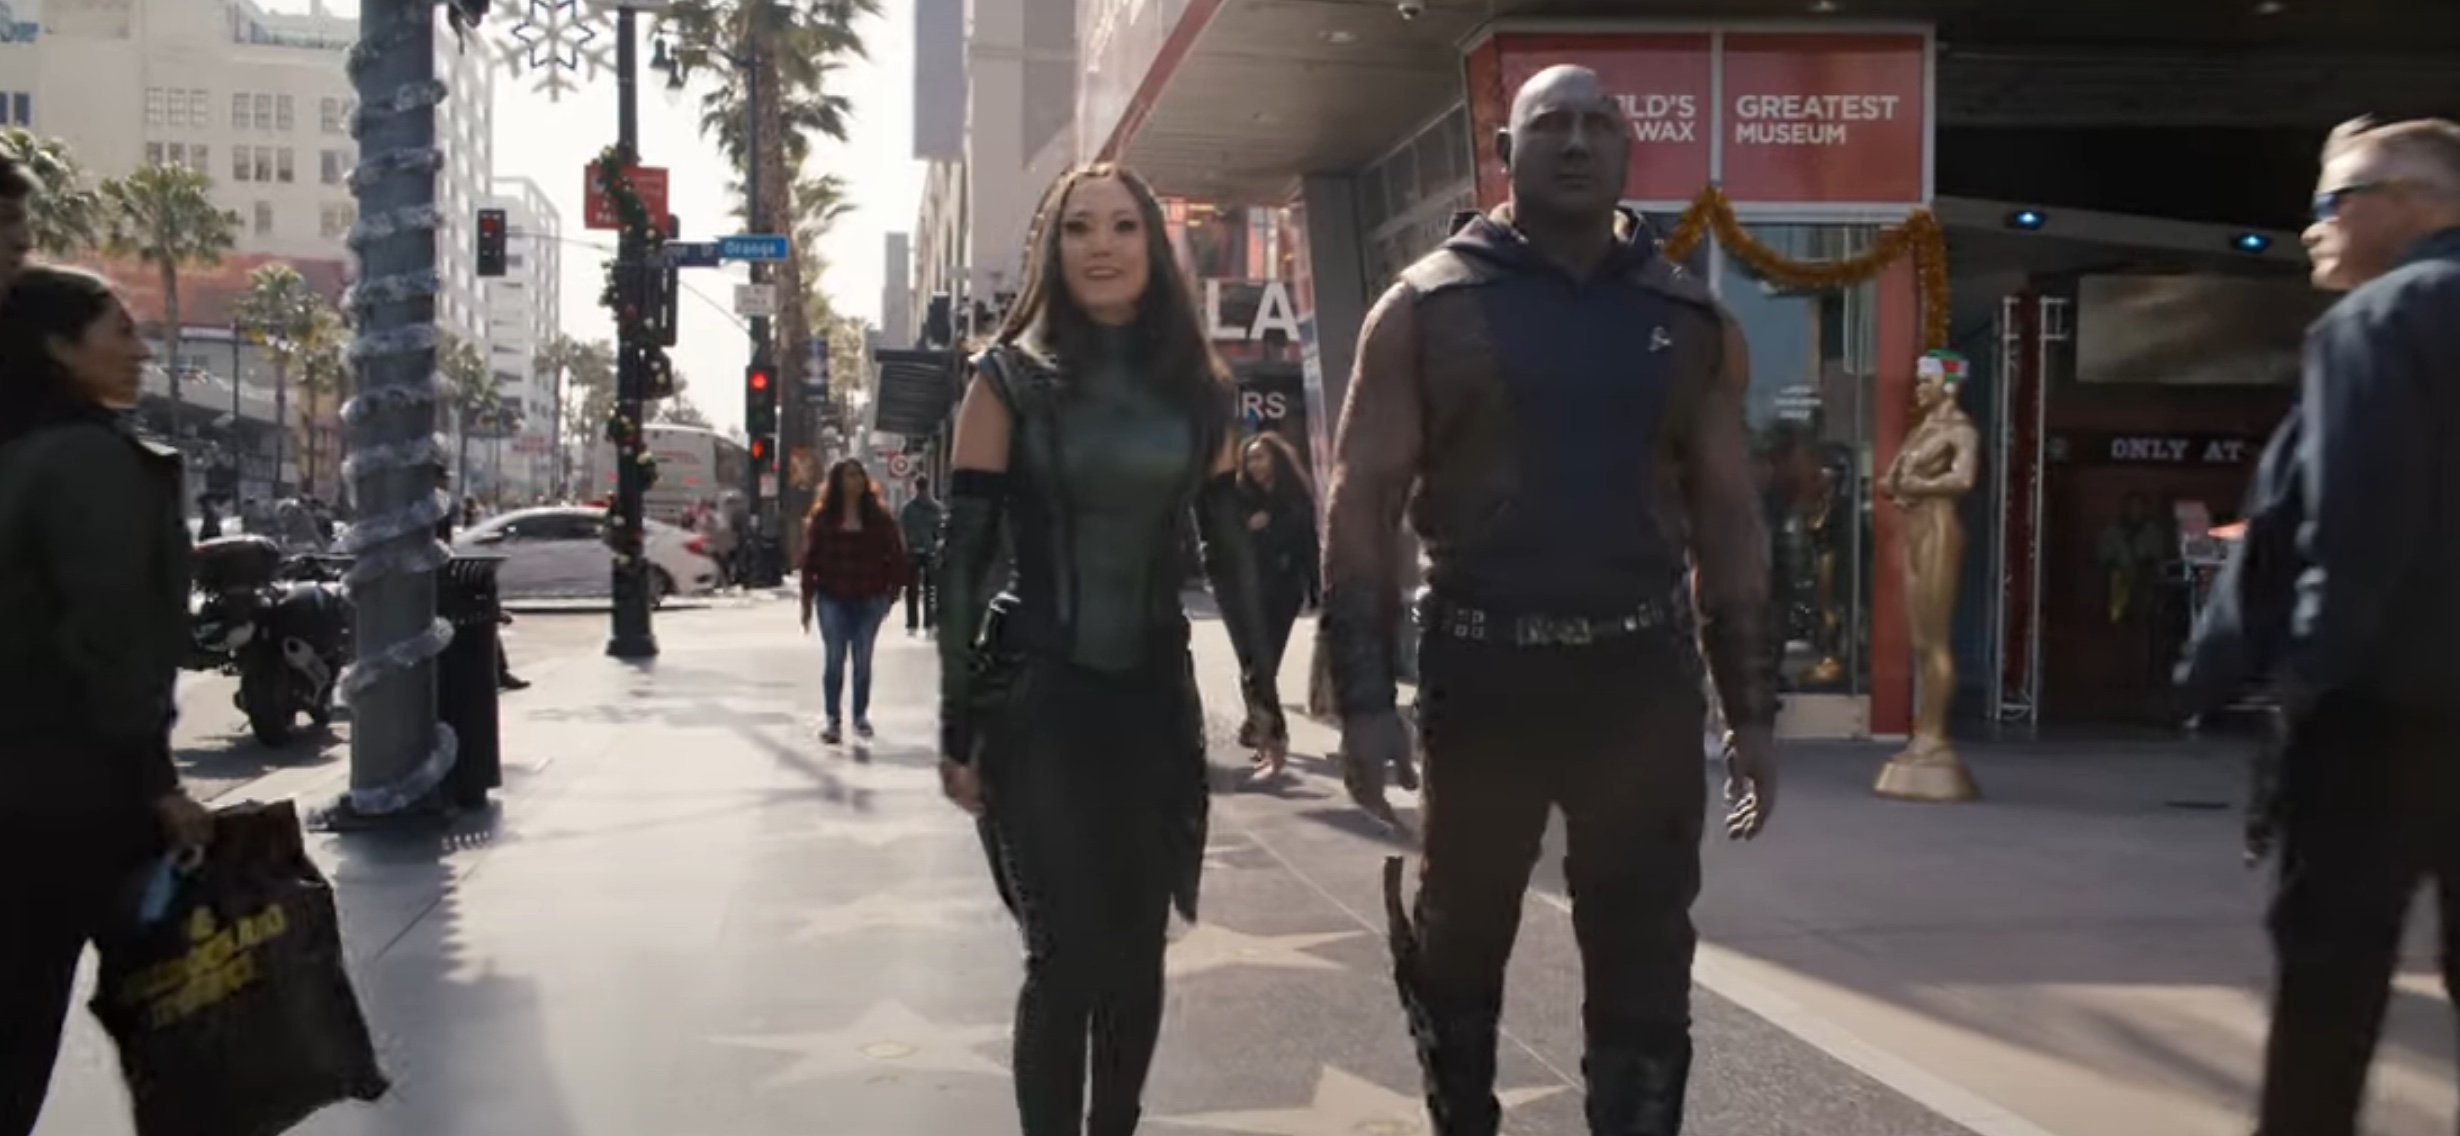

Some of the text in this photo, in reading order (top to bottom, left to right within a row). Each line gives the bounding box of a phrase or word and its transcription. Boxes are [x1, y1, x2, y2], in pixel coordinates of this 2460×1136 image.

[1736, 95, 1899, 119] GREATEST
[1633, 122, 1846, 144] WAX MUSEUM
[725, 241, 777, 257] Orange
[1206, 279, 1300, 341] LA
[2111, 437, 2243, 461] ONLY AT
